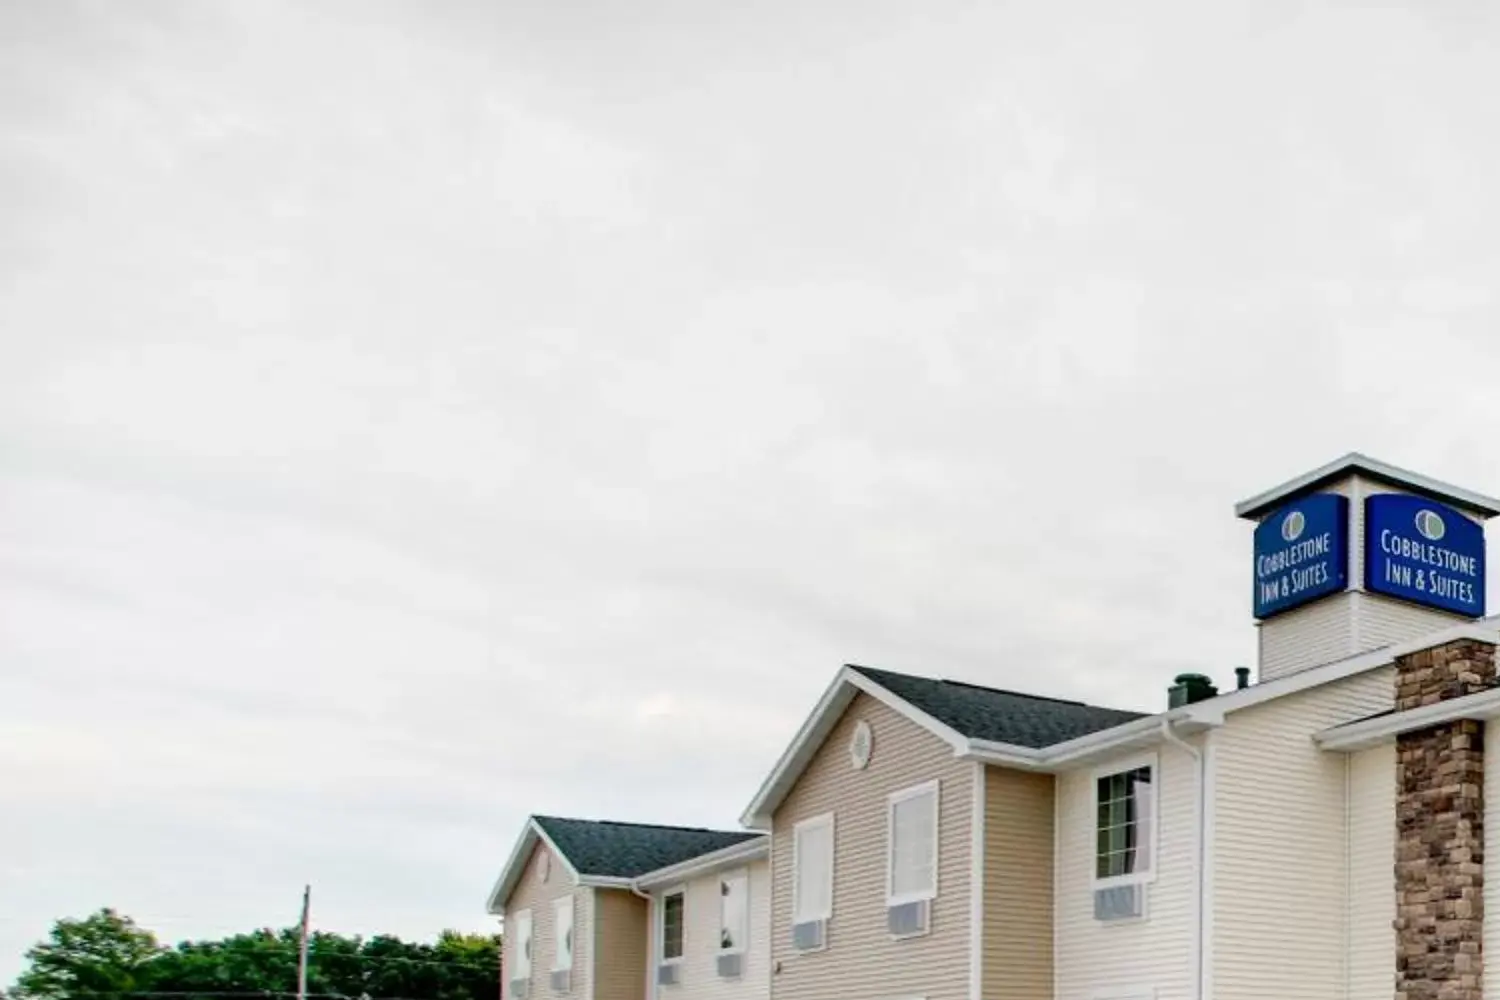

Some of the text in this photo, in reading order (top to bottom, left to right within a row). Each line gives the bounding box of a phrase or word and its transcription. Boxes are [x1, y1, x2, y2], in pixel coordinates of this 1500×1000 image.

[1257, 532, 1331, 578] COBBLESTONE
[1381, 529, 1477, 577] COBBLESTONE
[1261, 561, 1328, 605] INN & SUITES
[1385, 557, 1474, 604] INN & SUITES
